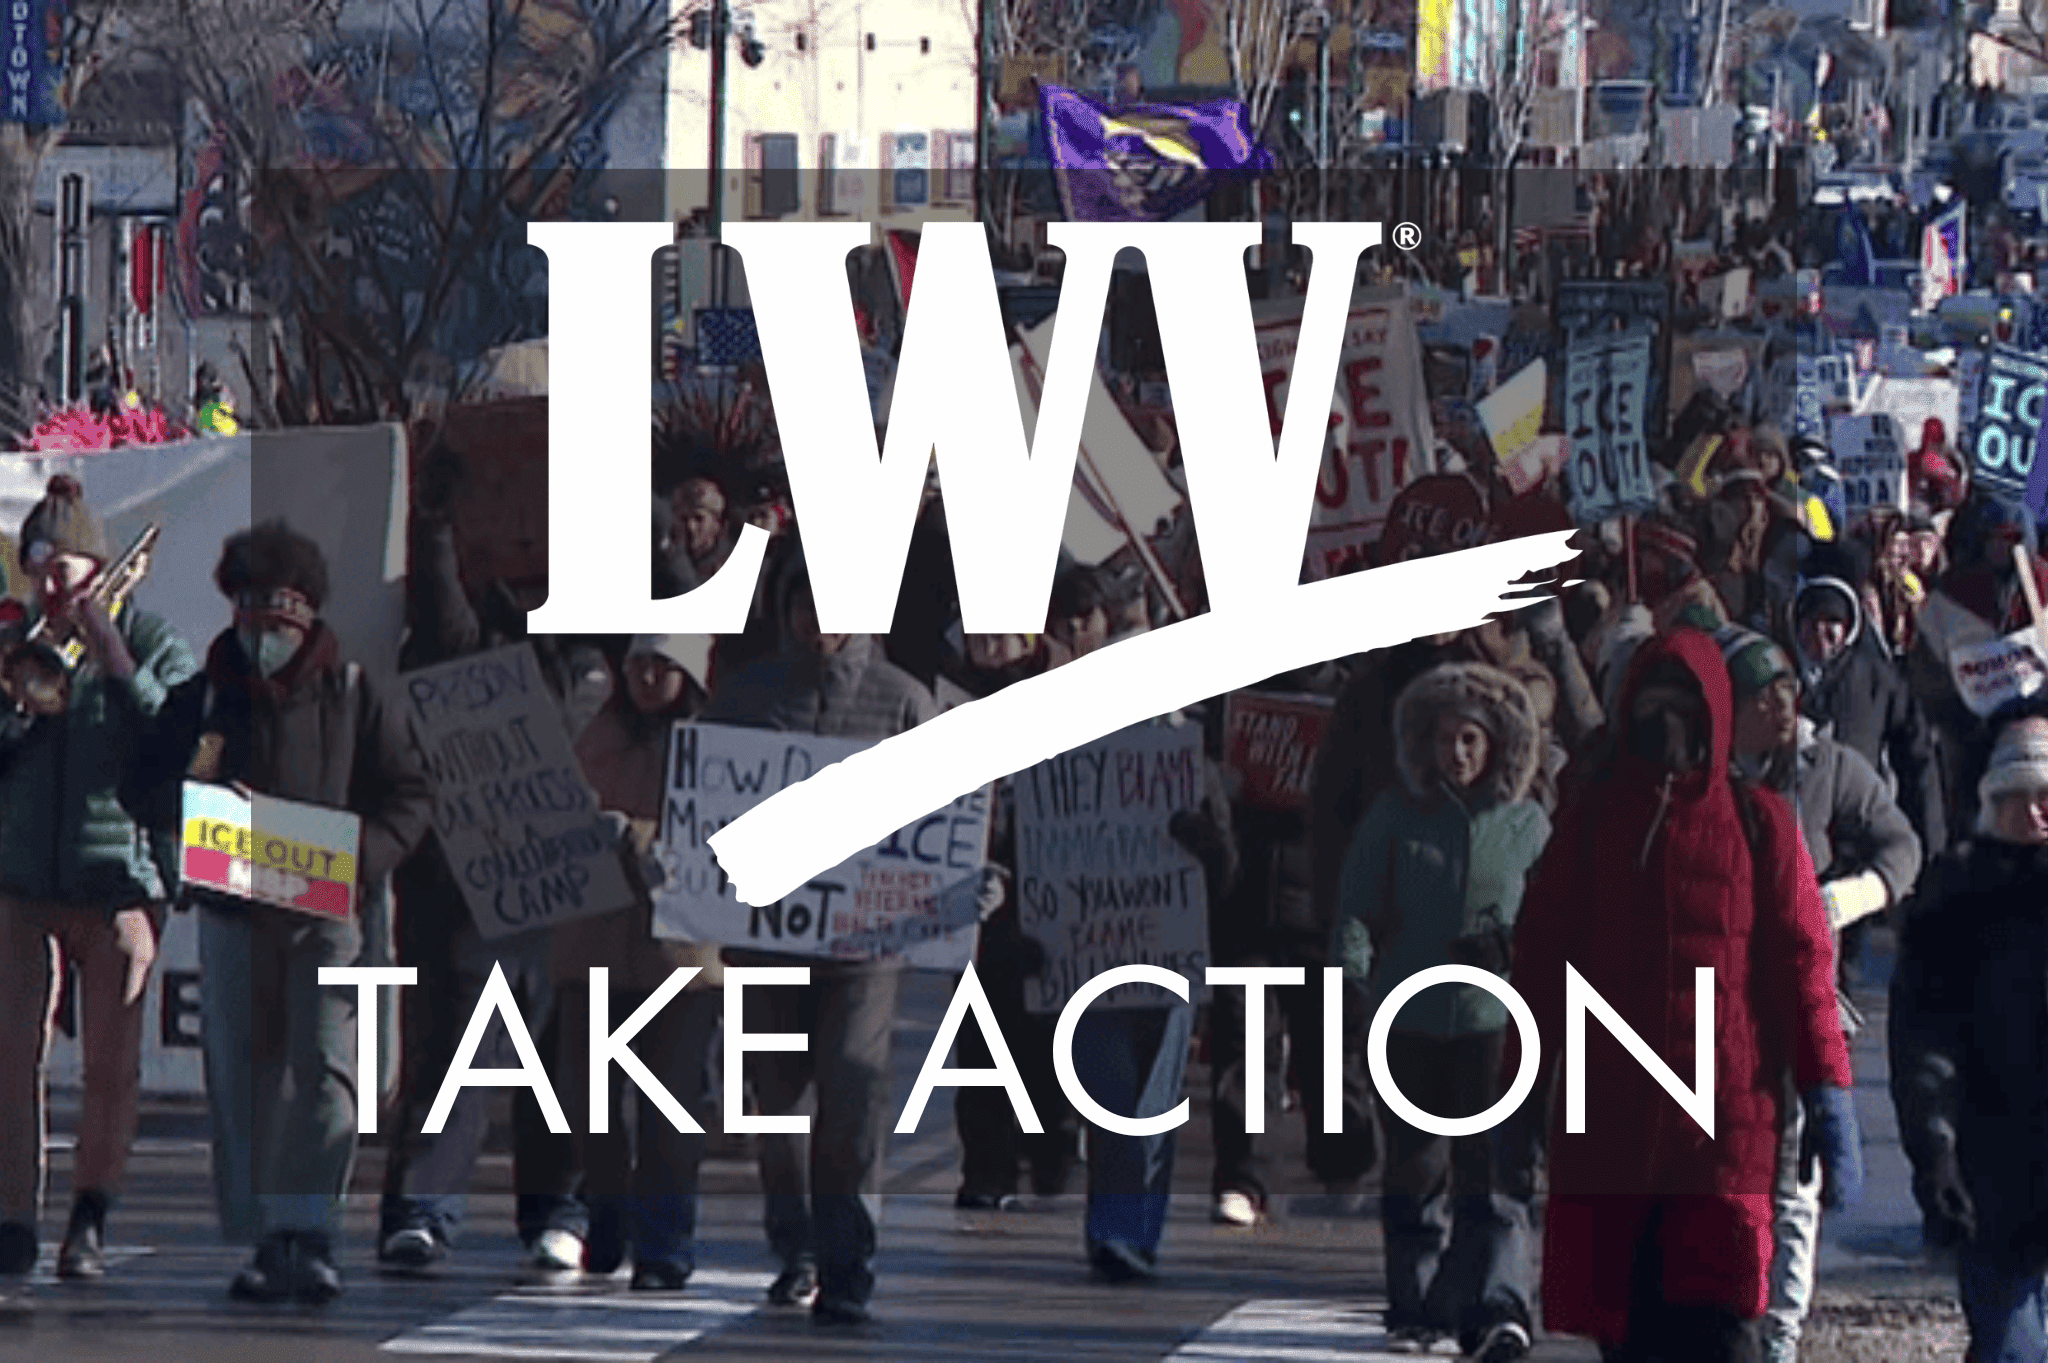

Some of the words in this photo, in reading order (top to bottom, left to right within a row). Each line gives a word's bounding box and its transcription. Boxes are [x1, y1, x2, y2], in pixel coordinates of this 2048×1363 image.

[1571, 381, 1634, 439] ICE
[1983, 374, 2047, 428] IC
[1576, 439, 1642, 497] OUT!
[1977, 424, 2036, 476] OU
[408, 652, 528, 722] PRISON
[428, 713, 542, 784] WITHOUT
[198, 818, 255, 858] ICE
[264, 839, 337, 878] OUT
[876, 814, 980, 870] ICE
[494, 863, 590, 925] CAMP
[1023, 875, 1059, 925] SO
